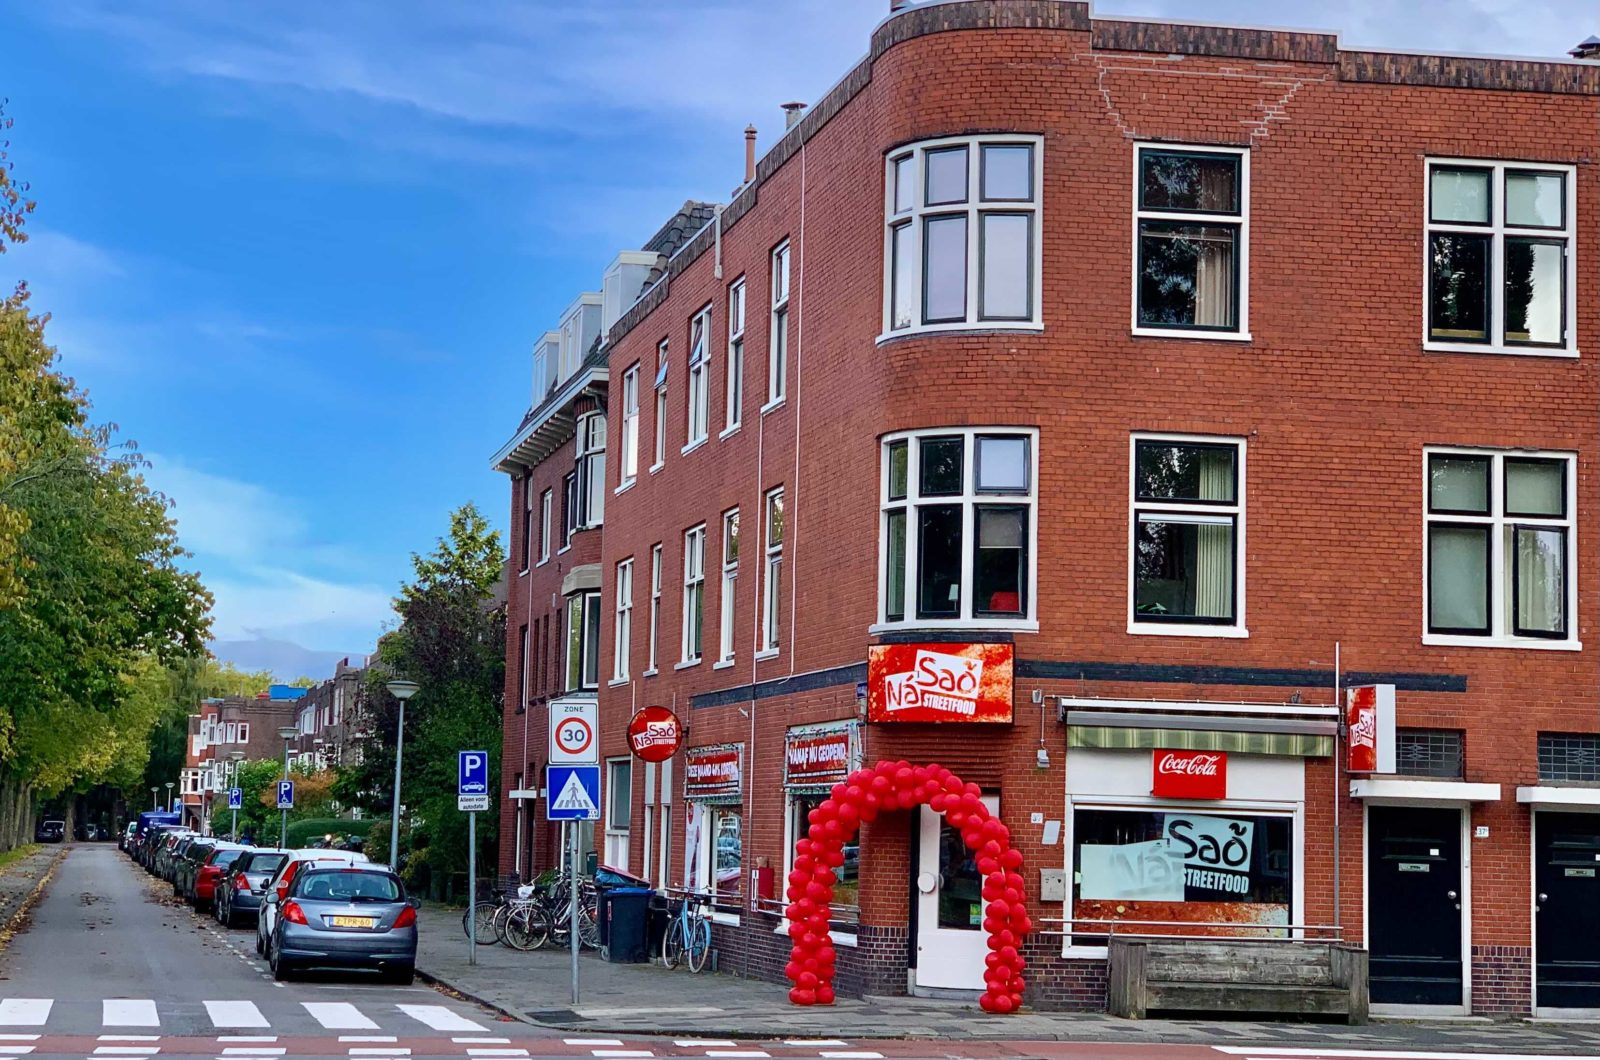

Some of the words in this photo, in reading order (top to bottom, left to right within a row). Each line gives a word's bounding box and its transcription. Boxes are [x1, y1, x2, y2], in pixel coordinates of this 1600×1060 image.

[887, 674, 919, 707] Ná
[922, 693, 976, 715] STREETFOOD
[563, 729, 585, 742] 30
[465, 755, 481, 777] P
[1159, 753, 1220, 775] Coca-Cola
[232, 789, 239, 799] P
[281, 782, 291, 794] P
